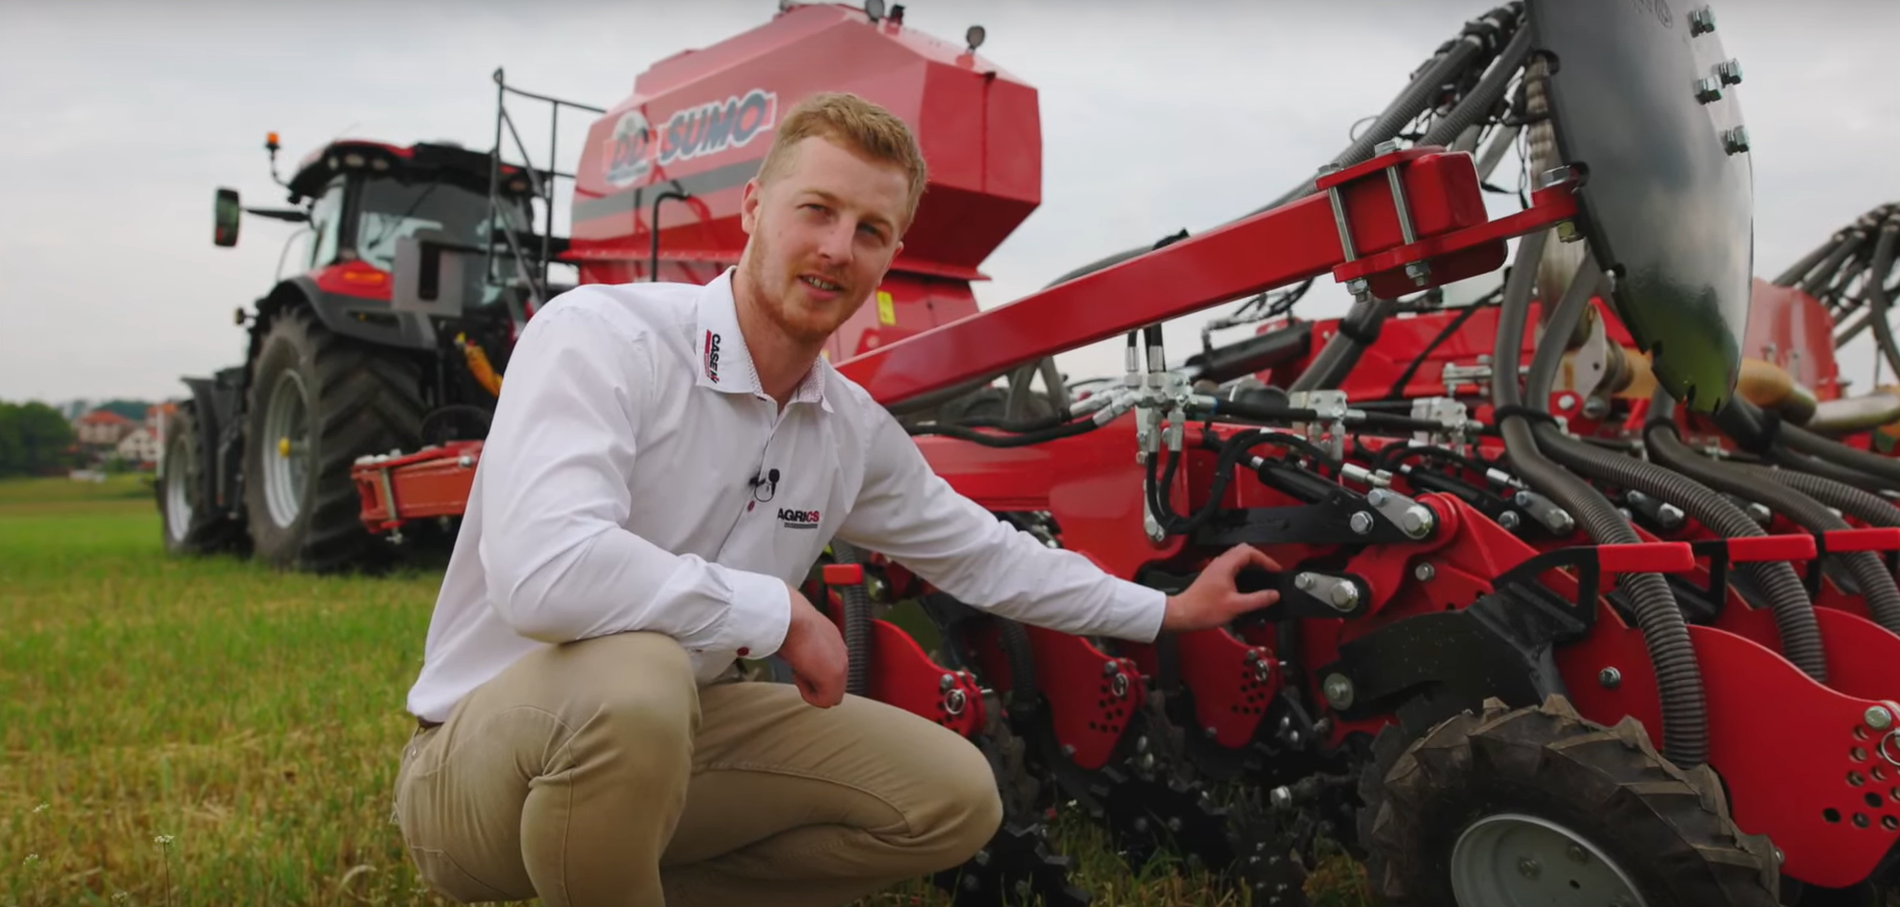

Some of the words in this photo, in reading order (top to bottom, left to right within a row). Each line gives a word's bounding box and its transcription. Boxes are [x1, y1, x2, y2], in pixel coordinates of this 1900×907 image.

[659, 91, 768, 163] SUMO
[709, 333, 721, 371] CASE
[777, 507, 820, 522] AGRICS
